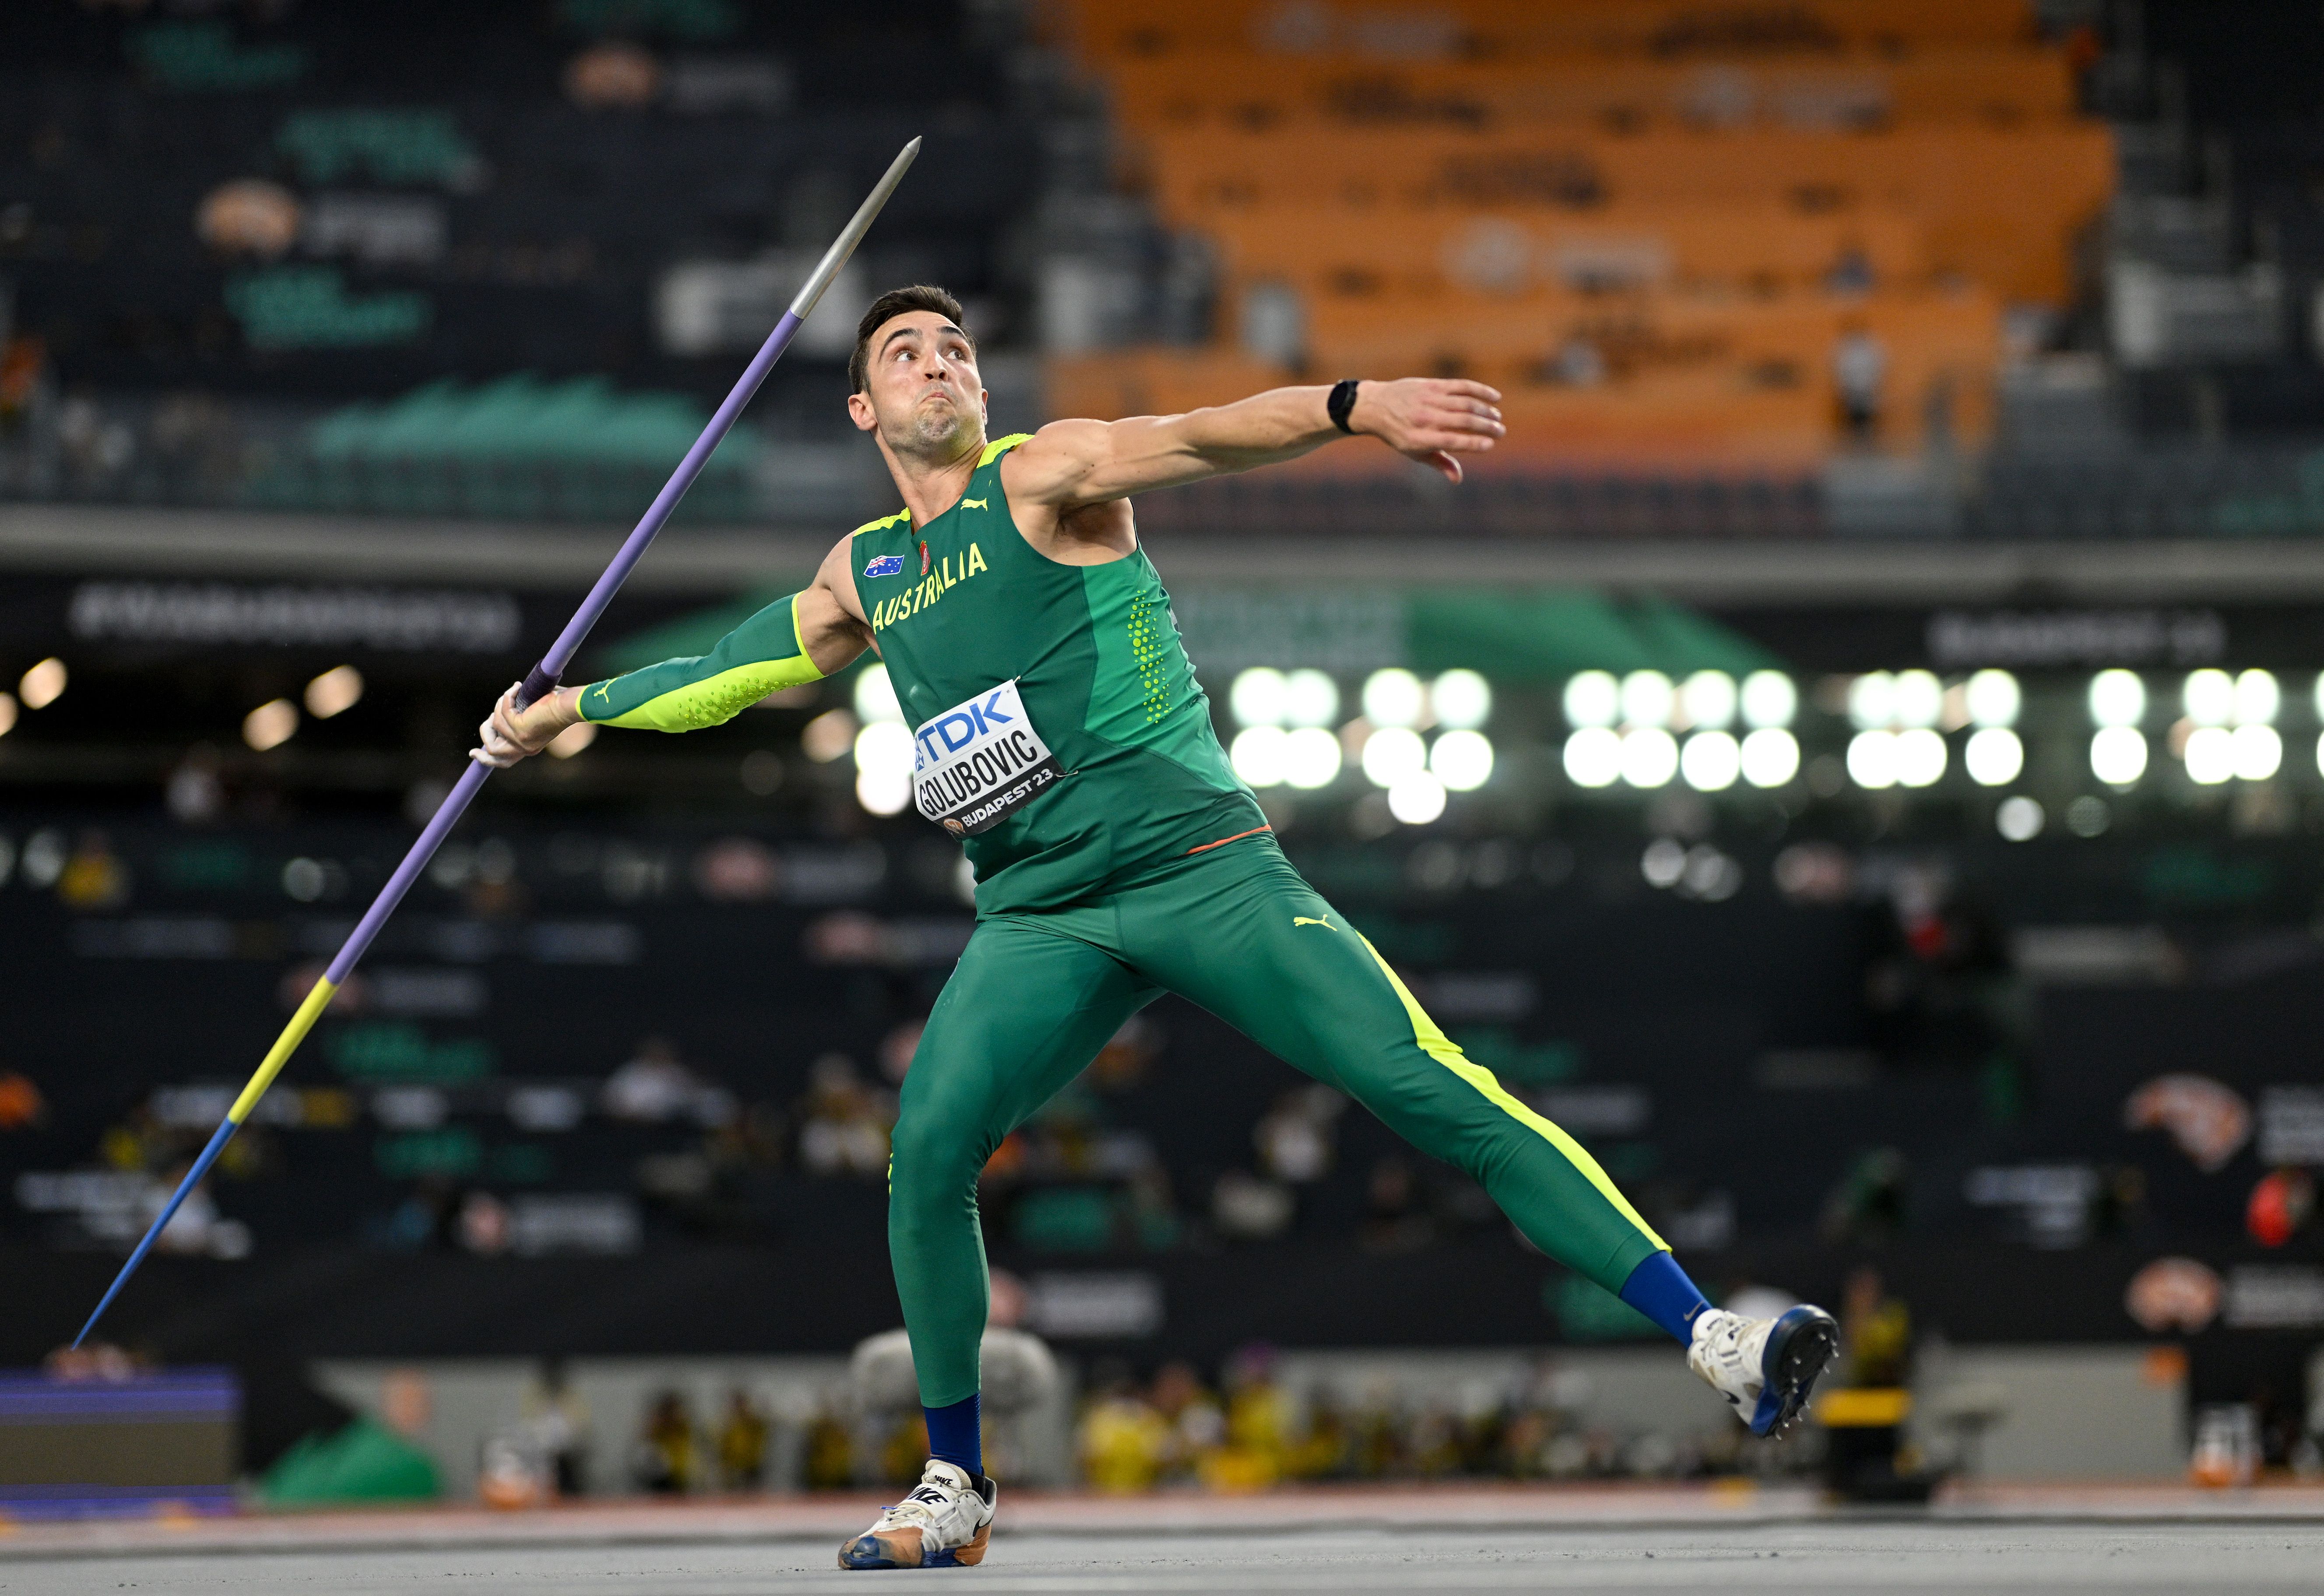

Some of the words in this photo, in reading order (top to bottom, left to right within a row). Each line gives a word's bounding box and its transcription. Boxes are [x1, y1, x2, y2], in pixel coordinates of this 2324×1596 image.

[872, 542, 988, 635] AUSTRALIA
[918, 690, 1014, 762] TDK
[919, 730, 1037, 817] GOLUBOVIC
[961, 780, 1031, 827] BUDAPEST
[1032, 768, 1053, 786] 23
[934, 1474, 953, 1485] NIKE
